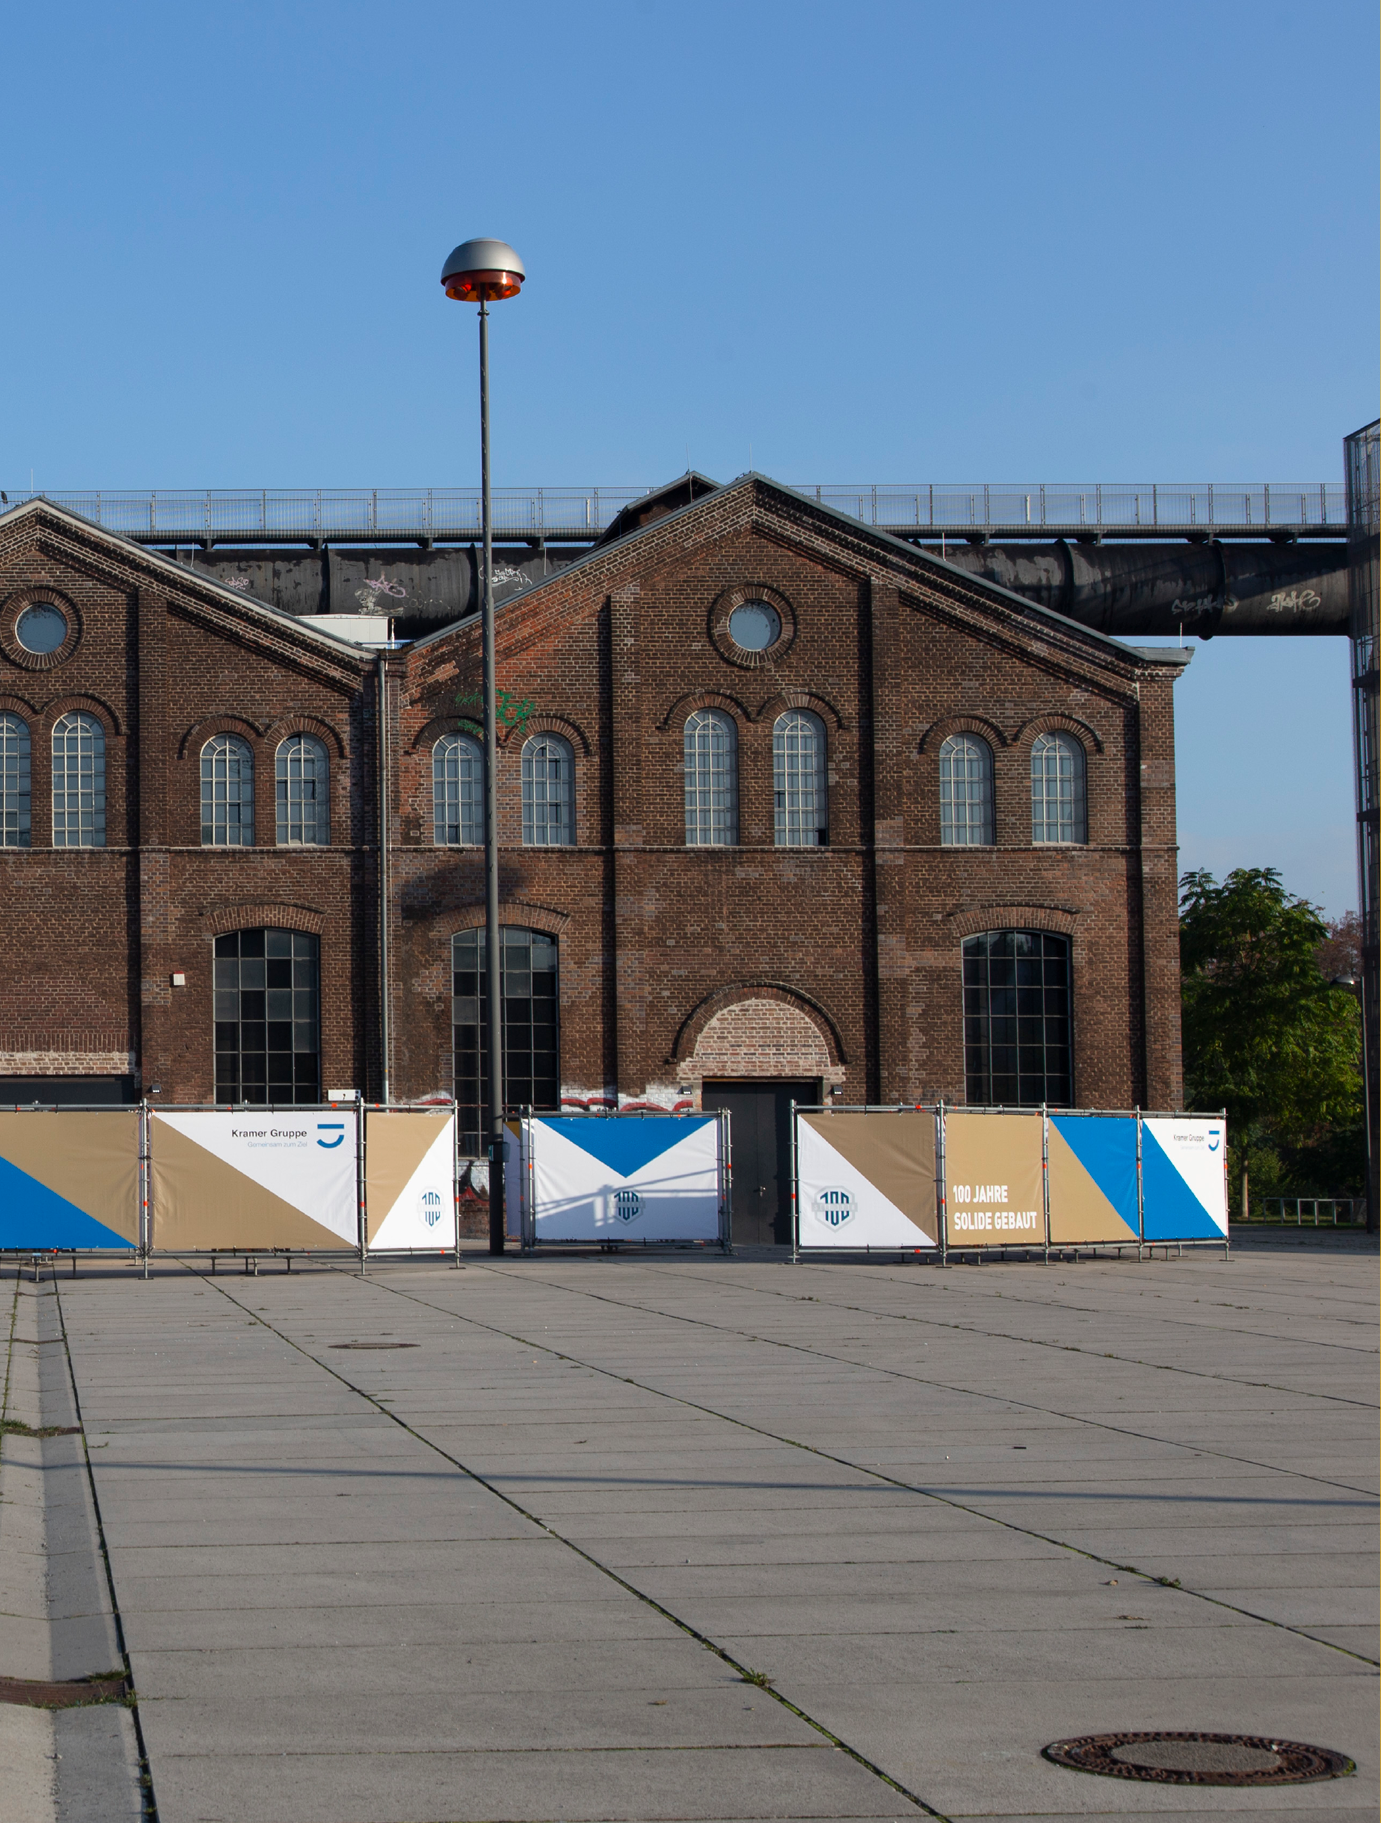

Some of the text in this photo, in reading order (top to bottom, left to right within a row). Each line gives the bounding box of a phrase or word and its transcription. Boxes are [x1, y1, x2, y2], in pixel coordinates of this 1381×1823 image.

[231, 1128, 308, 1139] Kramer Gruppe
[953, 1185, 1008, 1203] 100 JAHRE
[954, 1211, 1037, 1230] SOLIDE GEBAUT
